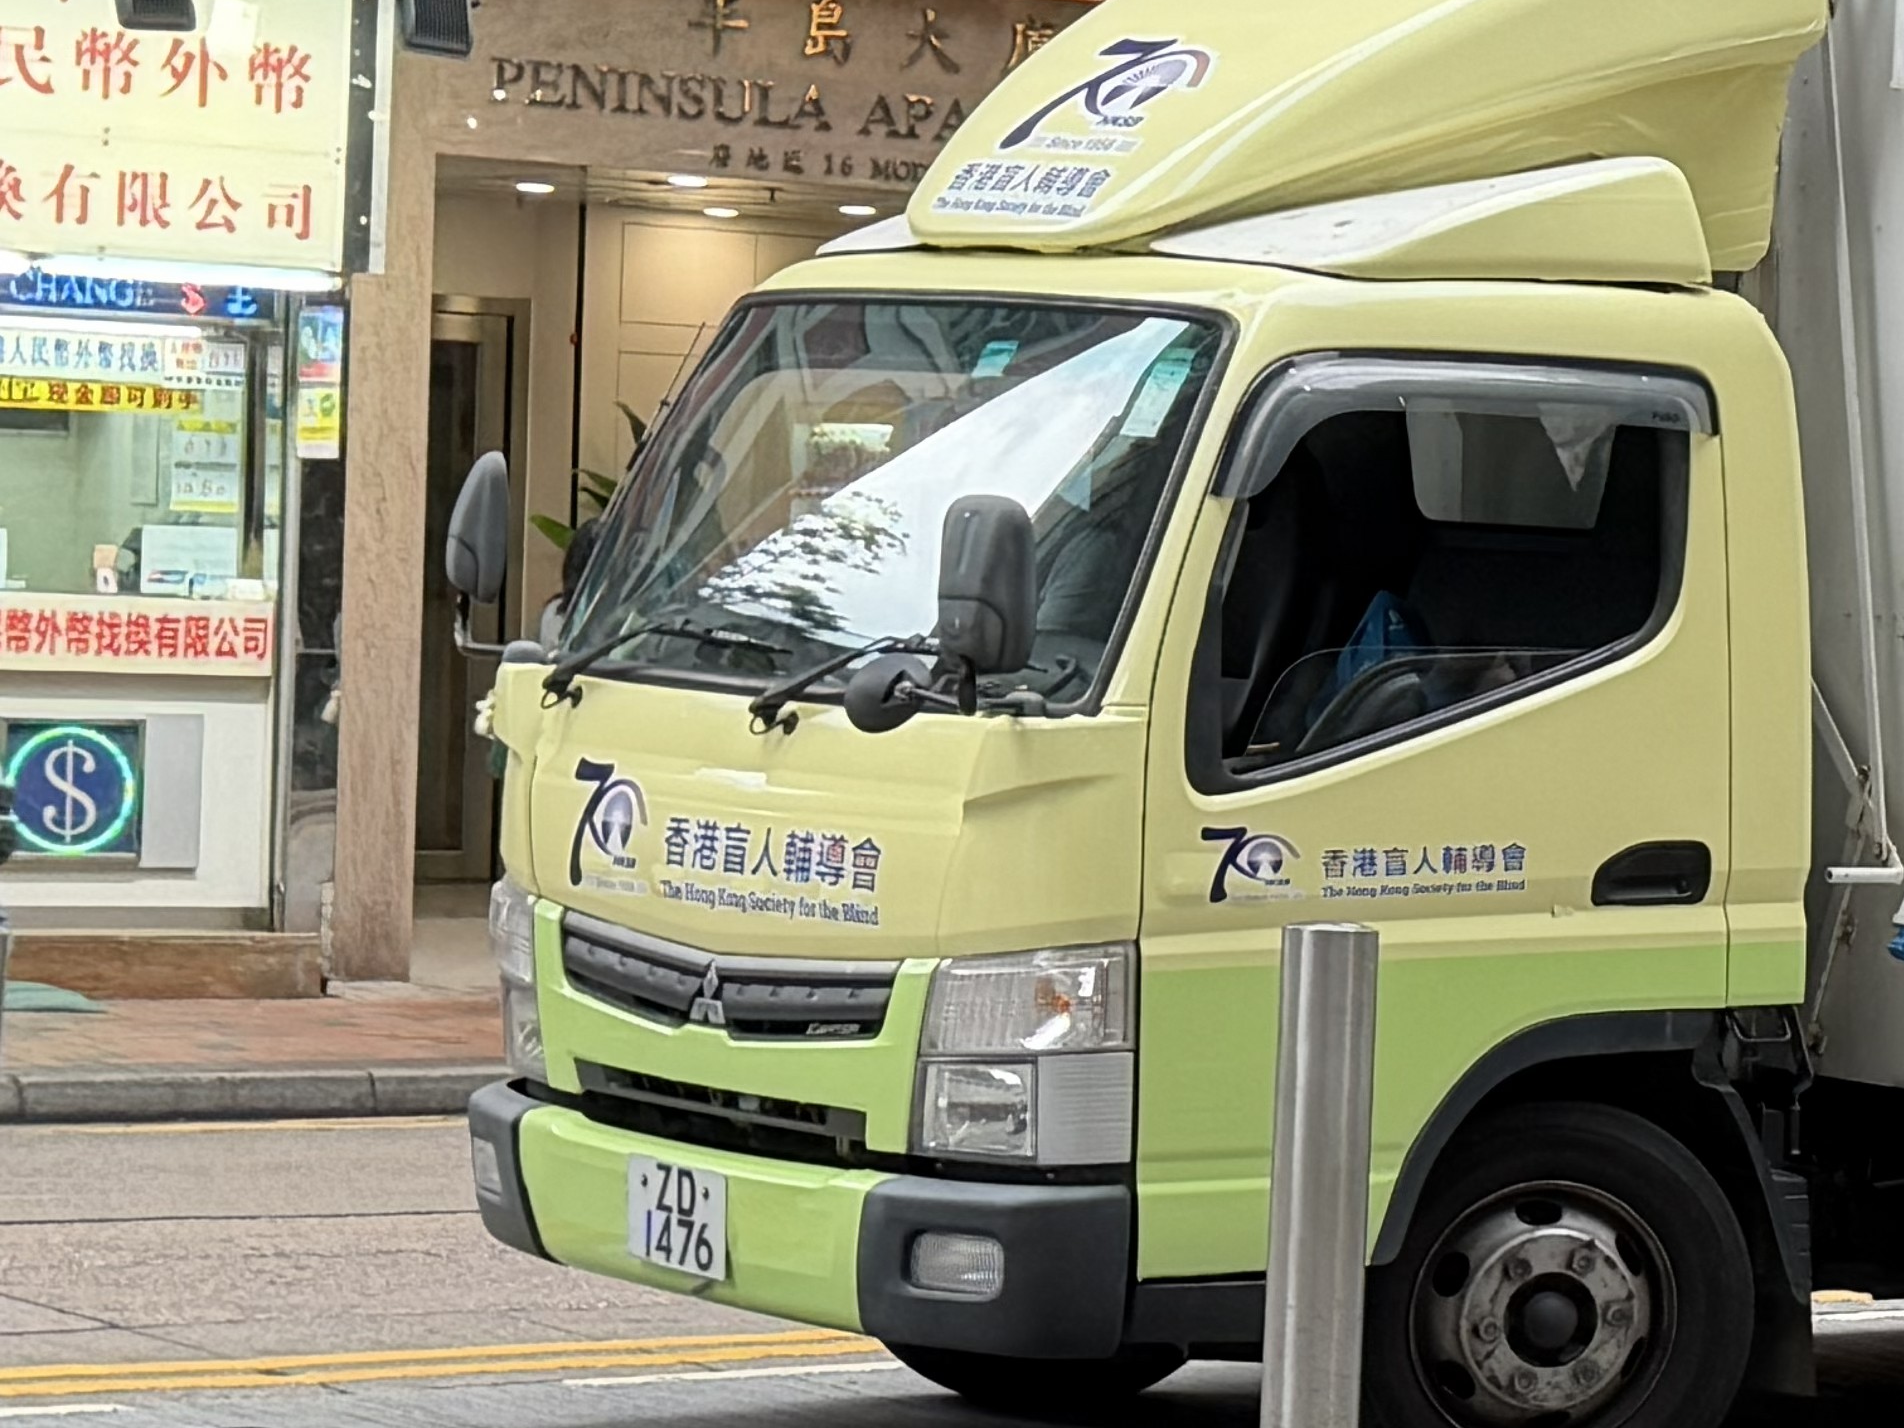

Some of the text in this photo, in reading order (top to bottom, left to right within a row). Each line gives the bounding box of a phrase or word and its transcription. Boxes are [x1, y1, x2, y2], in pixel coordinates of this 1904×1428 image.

[490, 56, 832, 132] PENINSULA
[823, 152, 854, 177] 16
[948, 163, 1111, 198] 香港盲人輔導會
[0, 335, 160, 373] 人民幣外幣找換
[664, 816, 882, 893] 香港盲人輔導會
[1320, 841, 1527, 881] 香港盲人輔導會
[659, 879, 683, 902] The
[685, 882, 715, 911] Hong
[718, 887, 747, 914] Kong
[749, 891, 797, 920] Society
[800, 896, 816, 918] for
[818, 899, 840, 921] the
[841, 902, 880, 926] Blind
[1321, 879, 1526, 899] The Hong Kong Society for the Blind
[655, 1162, 697, 1218] ZD
[645, 1208, 714, 1272] 1476
